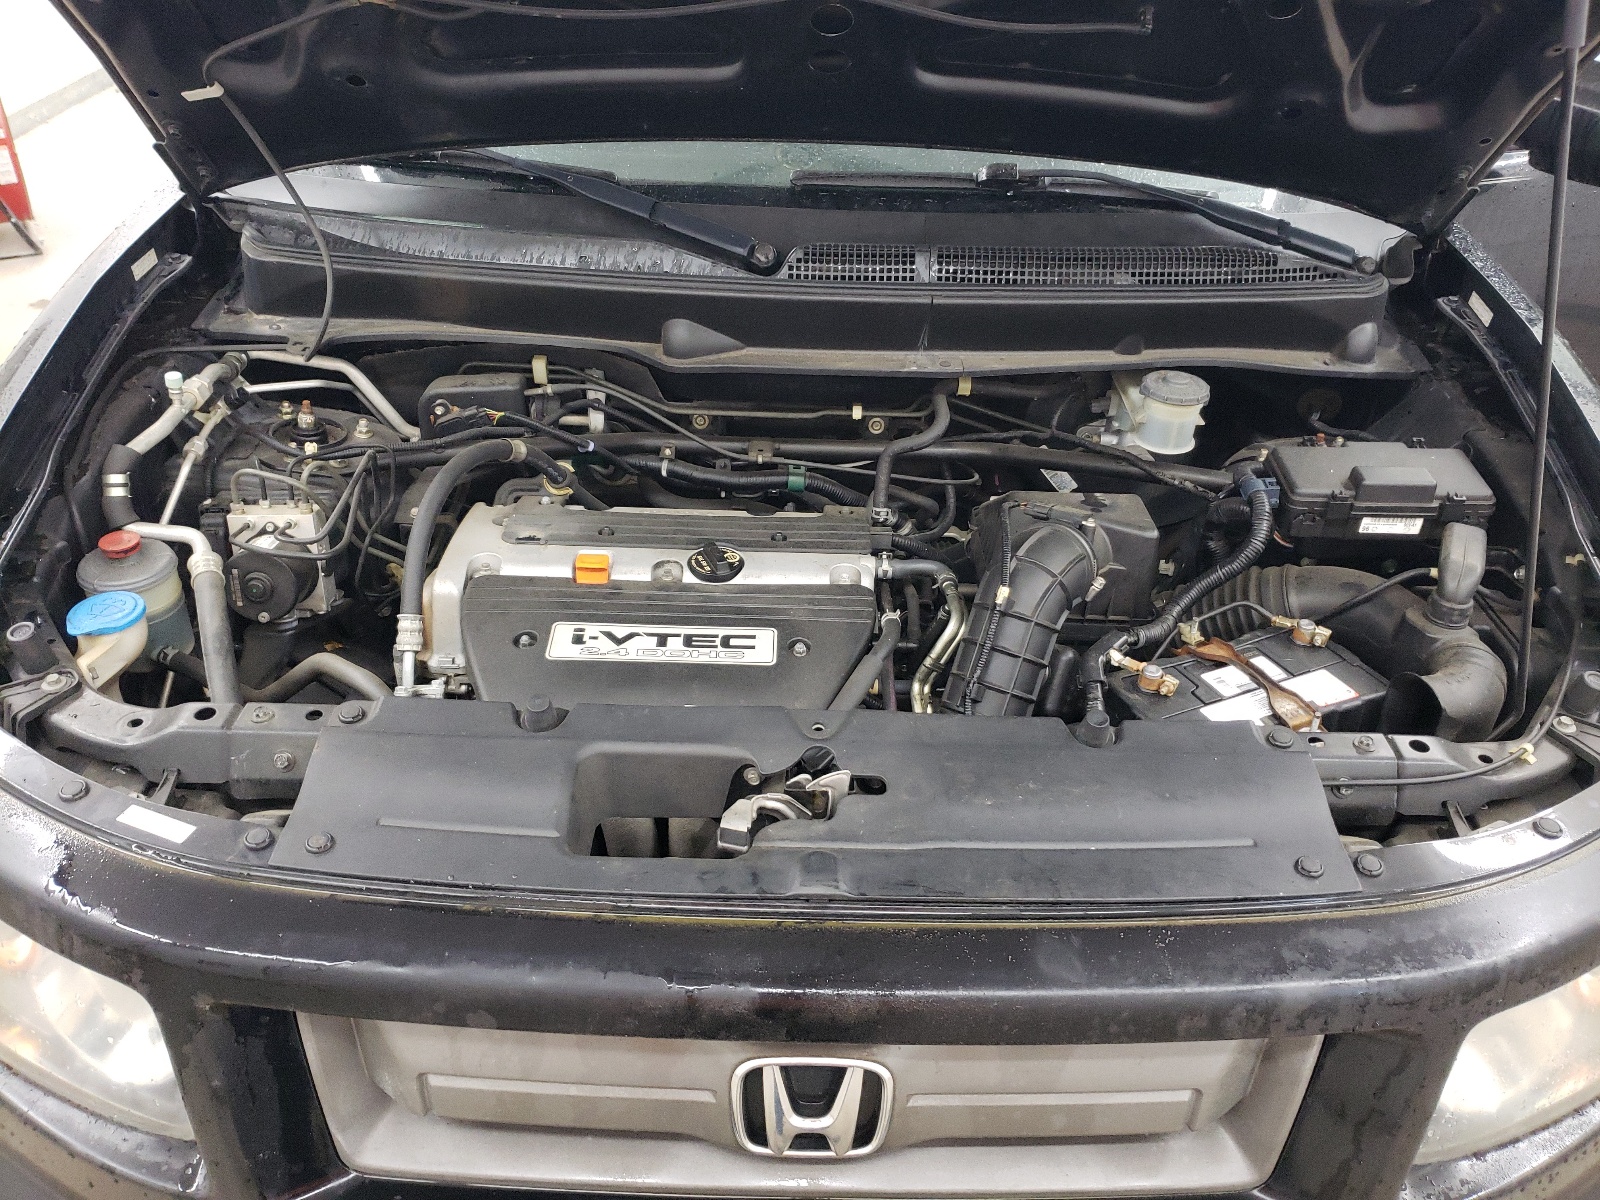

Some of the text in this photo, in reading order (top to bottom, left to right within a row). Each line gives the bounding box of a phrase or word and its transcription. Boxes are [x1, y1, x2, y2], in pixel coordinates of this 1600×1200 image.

[571, 627, 757, 650] i-VTEC
[580, 646, 745, 660] 2.4 DOHC
